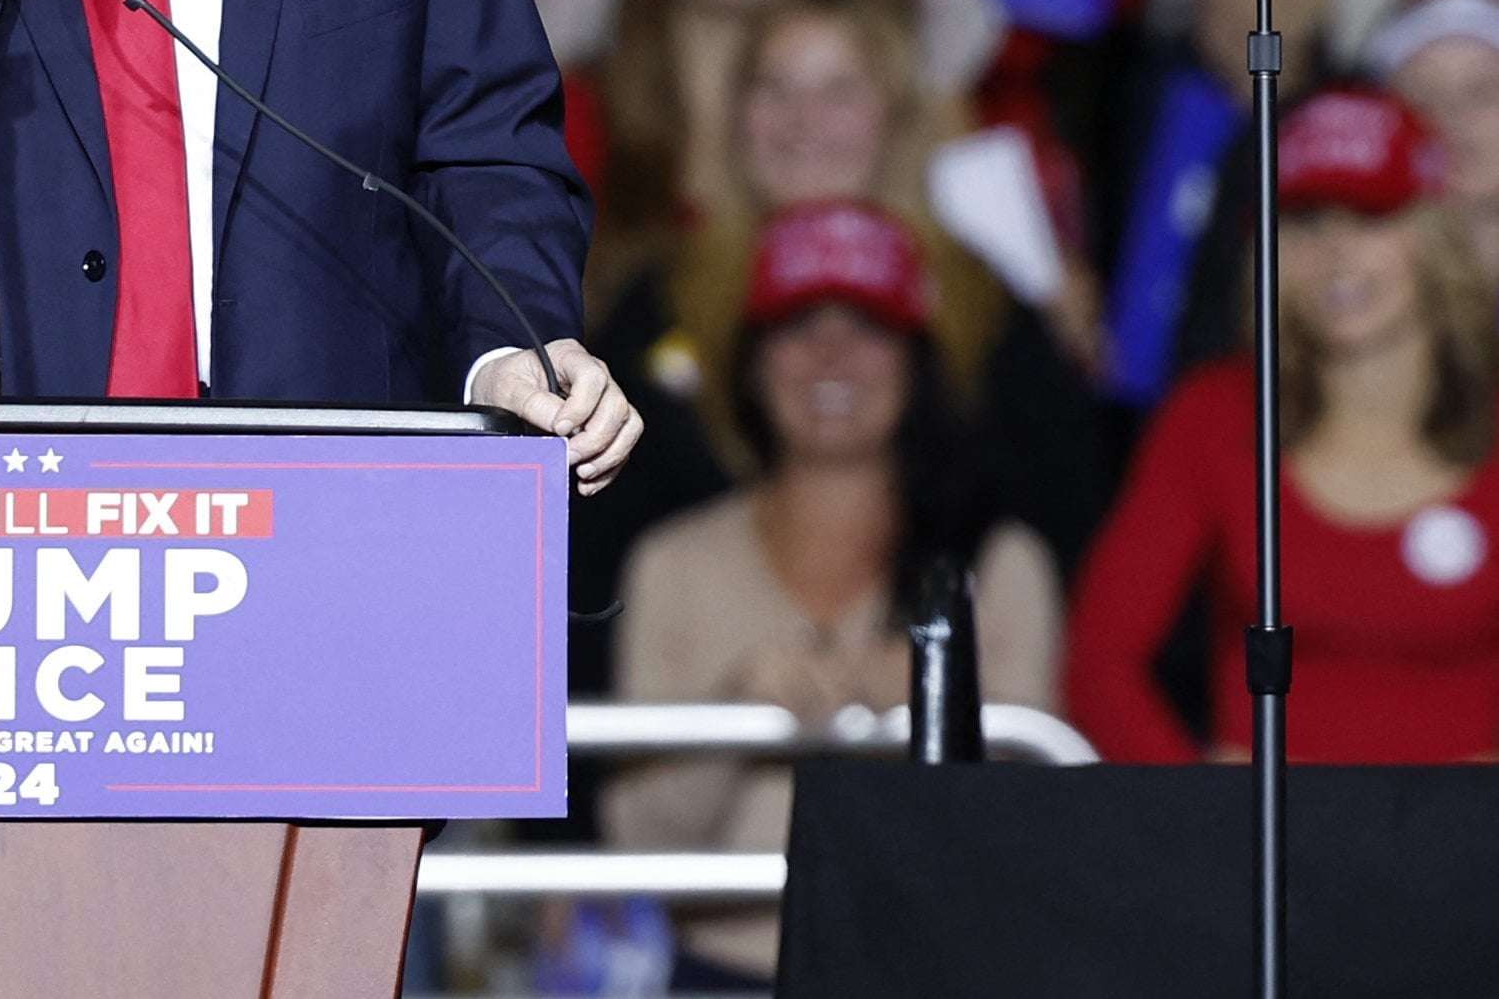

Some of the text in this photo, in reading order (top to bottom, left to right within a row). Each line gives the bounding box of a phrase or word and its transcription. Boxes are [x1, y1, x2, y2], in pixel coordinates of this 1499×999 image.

[86, 492, 179, 534] FIX
[195, 492, 249, 535] IT
[103, 731, 215, 754] AGAIN!
